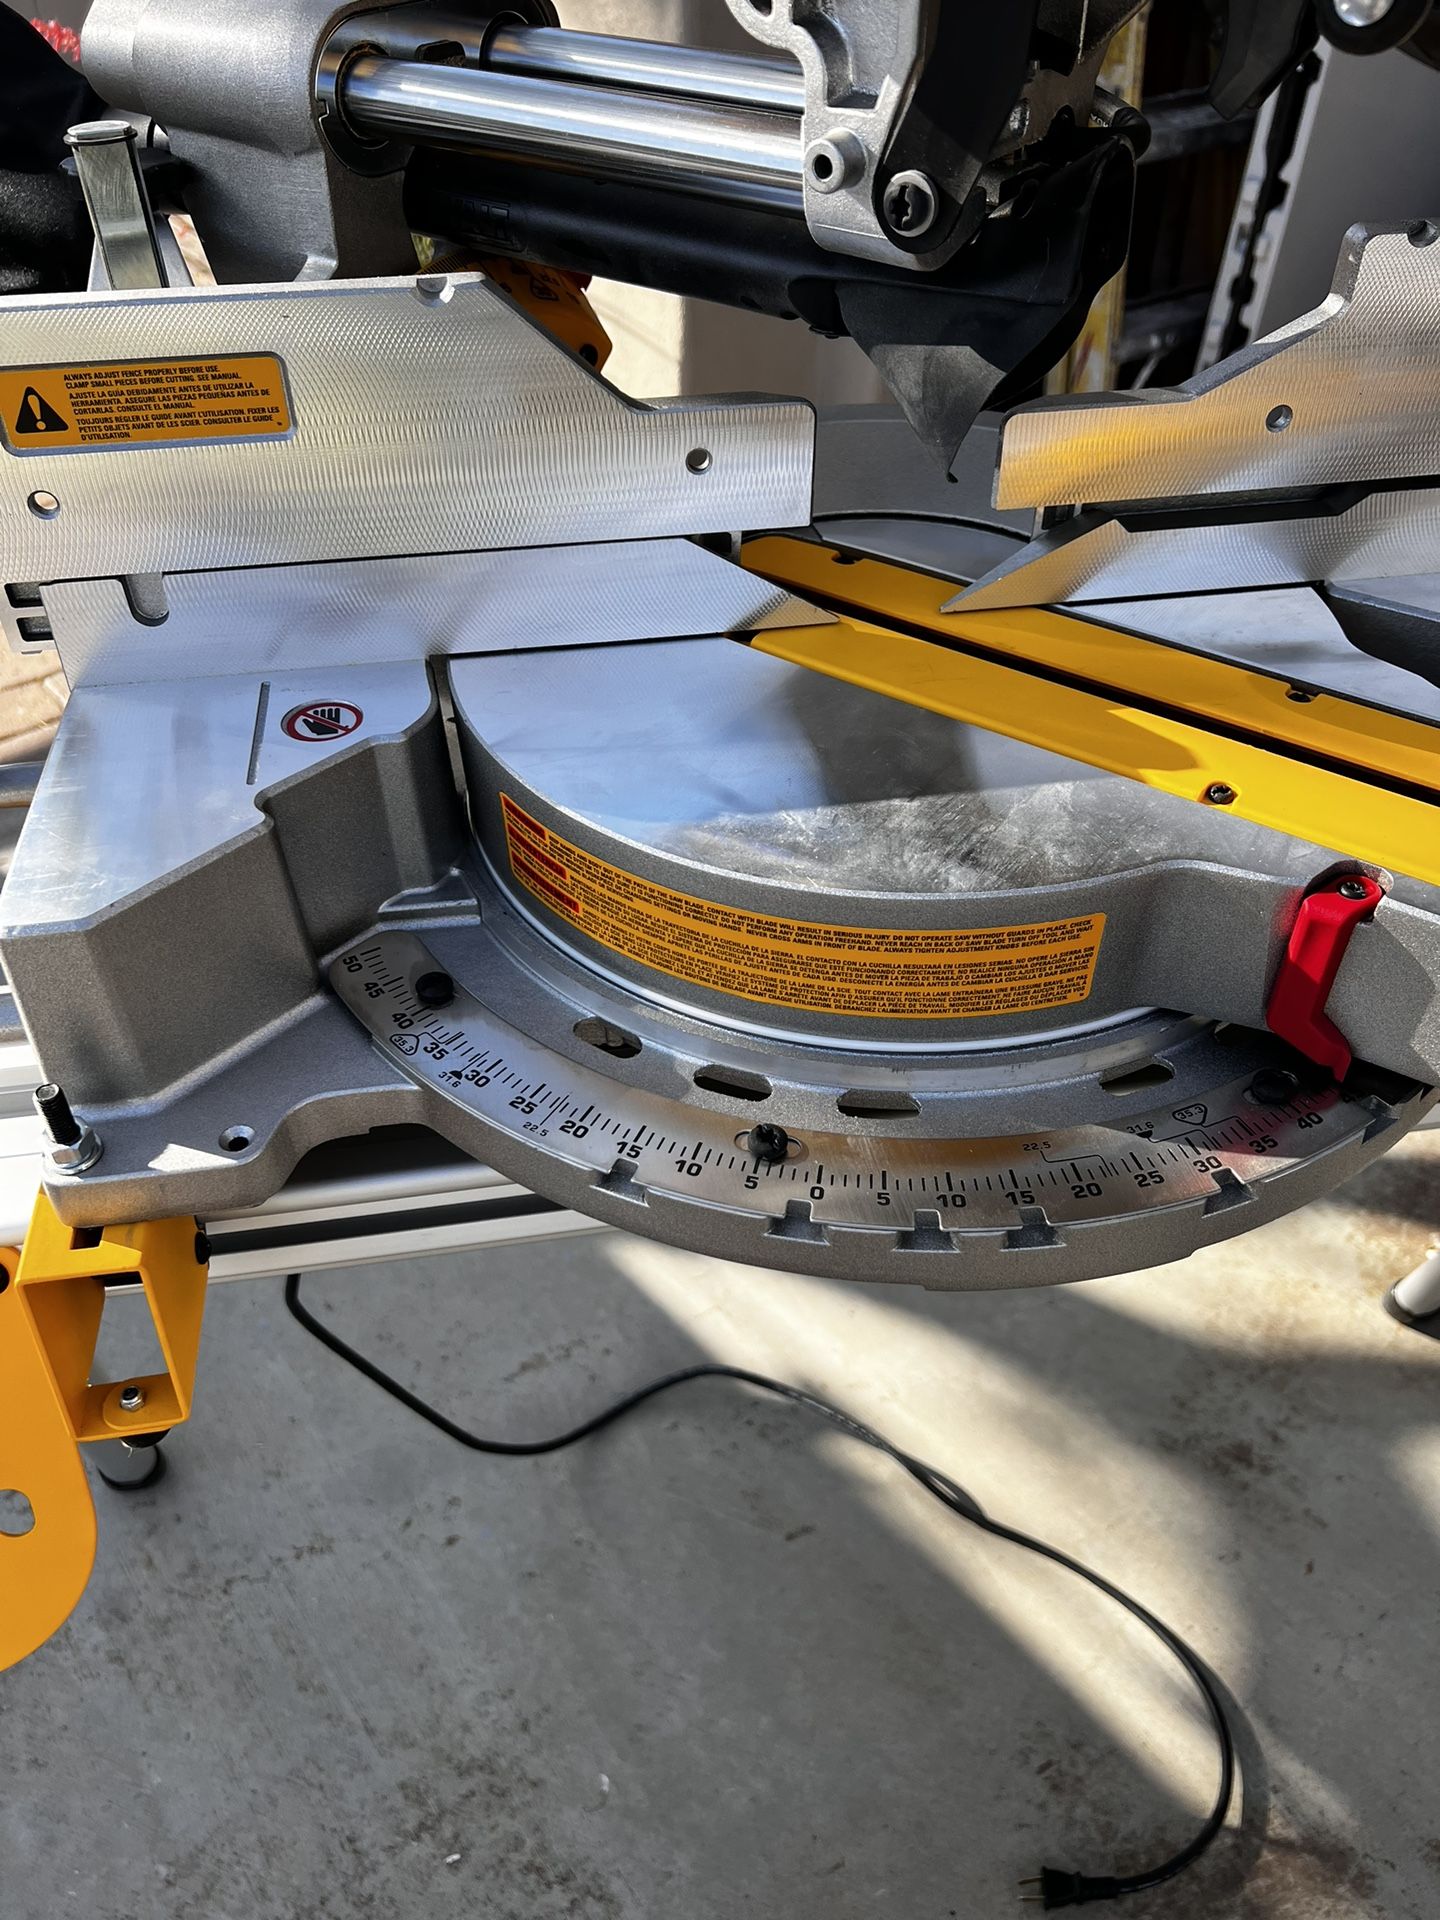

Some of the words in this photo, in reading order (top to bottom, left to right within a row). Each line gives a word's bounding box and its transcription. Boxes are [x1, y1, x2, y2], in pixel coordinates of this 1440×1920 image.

[63, 373, 92, 381] ALWAYS
[94, 371, 120, 380] ADJUST
[121, 370, 142, 378] FENCE
[143, 368, 178, 377] PROPERLY
[179, 366, 204, 375] BEFORE
[65, 381, 89, 390] CLAMP
[91, 379, 114, 388] SMALL
[115, 378, 138, 387] PIECES
[139, 377, 164, 385] BEFORE
[197, 374, 210, 382] SEE
[69, 391, 96, 400] AJUSTE
[127, 387, 176, 396] DEBIDAMENTE
[179, 385, 201, 393] ANTES
[213, 383, 244, 391] UTILIZAR
[125, 396, 157, 404] ASEGURE
[173, 394, 197, 402] PIEZAS
[237, 390, 260, 398] ANTES
[76, 417, 114, 426] TOUJOURS
[142, 414, 150, 422] LE
[152, 413, 174, 421] GUIDE
[175, 411, 197, 420] AVANT
[267, 406, 280, 414] LES
[117, 404, 153, 413] CONSULTE
[154, 403, 162, 411] EL
[79, 425, 103, 434] PETITS
[103, 423, 131, 432] OBJETS
[132, 422, 155, 430] AVANT
[156, 421, 166, 429] DE
[167, 420, 179, 428] LES
[203, 416, 243, 426] CONSULTER
[252, 414, 273, 423] GUIDE
[342, 955, 363, 973] 50
[364, 982, 386, 998] 45
[392, 1012, 414, 1029] 40
[394, 1036, 414, 1052] 35.3
[423, 1042, 449, 1060] 35
[438, 1071, 461, 1088] 31.6
[464, 1070, 490, 1088] 30
[509, 1096, 538, 1114] 25
[1177, 1106, 1204, 1121] 35.3
[522, 1122, 550, 1137] 22.5
[559, 1120, 589, 1138] 20
[1126, 1122, 1154, 1134] 31.6
[1297, 1112, 1324, 1130] 40
[616, 1141, 644, 1159] 15
[1022, 1142, 1051, 1151] 22.5
[1248, 1135, 1278, 1153] 35
[674, 1160, 702, 1177] 10
[1192, 1156, 1222, 1173] 30
[744, 1175, 760, 1189] 5
[1134, 1170, 1165, 1188] 25
[810, 1186, 824, 1200] 0
[876, 1192, 891, 1206] 5
[1005, 1191, 1035, 1205] 15
[1070, 1182, 1103, 1199] 20
[936, 1194, 967, 1208] 10
